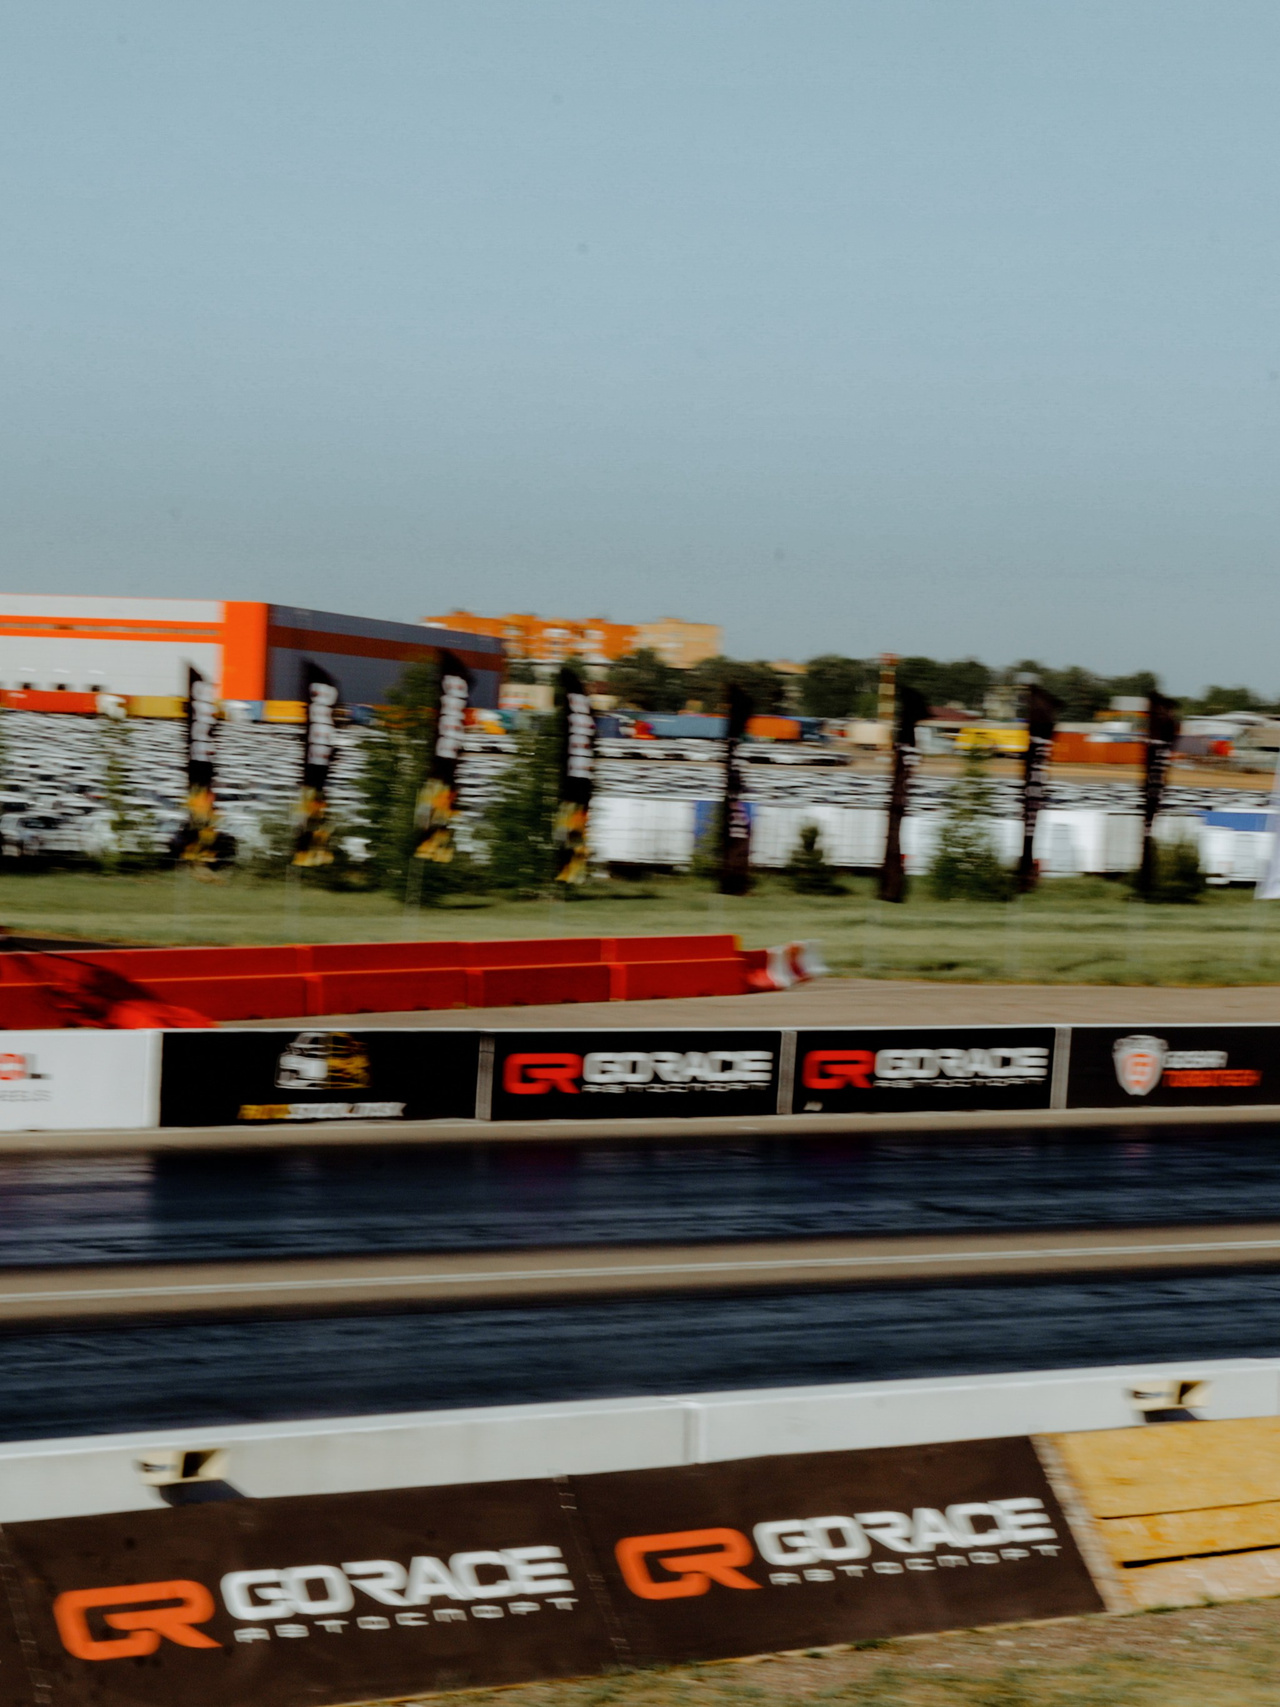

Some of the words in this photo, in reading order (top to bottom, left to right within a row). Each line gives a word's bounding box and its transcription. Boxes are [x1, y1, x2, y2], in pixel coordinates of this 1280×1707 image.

[583, 1051, 774, 1083] GORACE
[875, 1048, 1049, 1078] GORACE
[752, 1497, 1058, 1567] GORACE
[221, 1545, 575, 1622] GORACE
